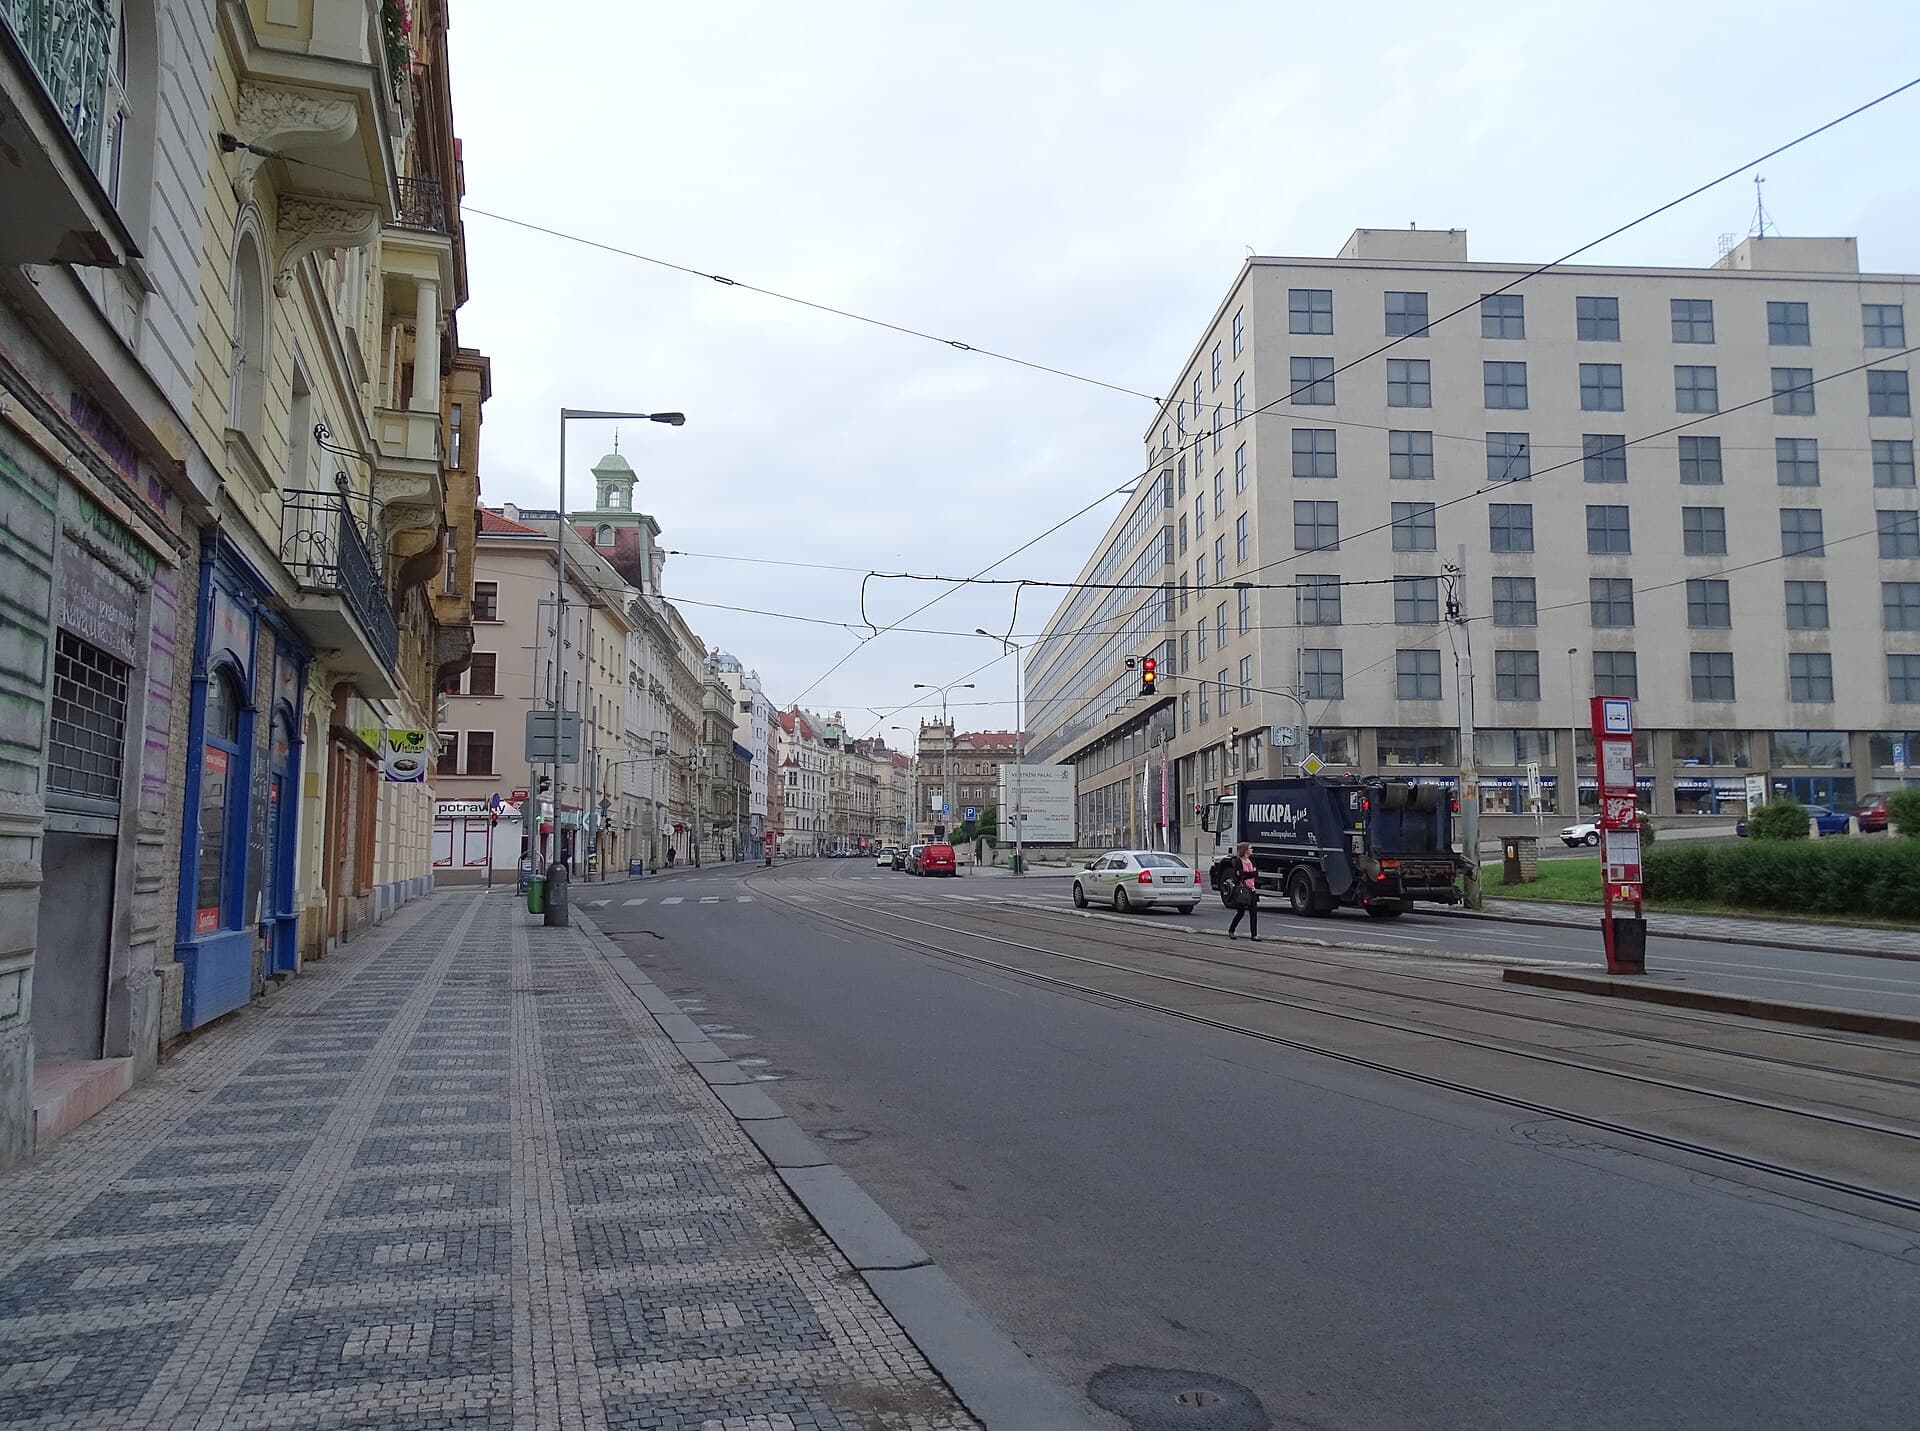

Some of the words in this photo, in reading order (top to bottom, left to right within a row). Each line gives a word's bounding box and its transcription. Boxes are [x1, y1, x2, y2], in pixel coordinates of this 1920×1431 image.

[967, 808, 973, 817] P
[1248, 804, 1292, 823] MIKAPA
[1292, 807, 1307, 830] plus
